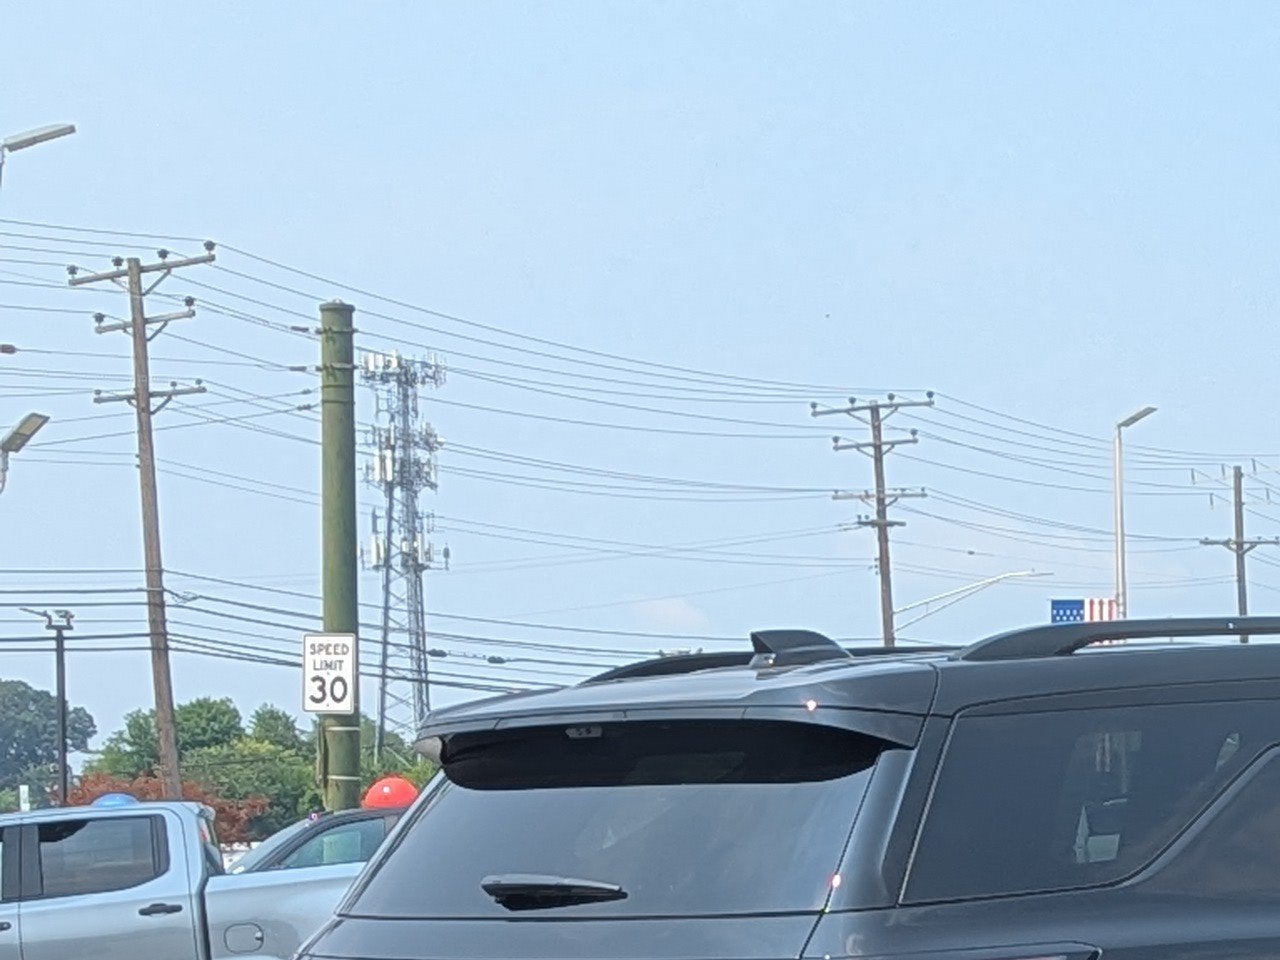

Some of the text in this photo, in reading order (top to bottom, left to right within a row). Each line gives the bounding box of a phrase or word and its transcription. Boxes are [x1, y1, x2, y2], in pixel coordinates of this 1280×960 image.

[310, 643, 349, 655] SPEED
[313, 660, 344, 671] LIMIT
[309, 675, 348, 704] 30
